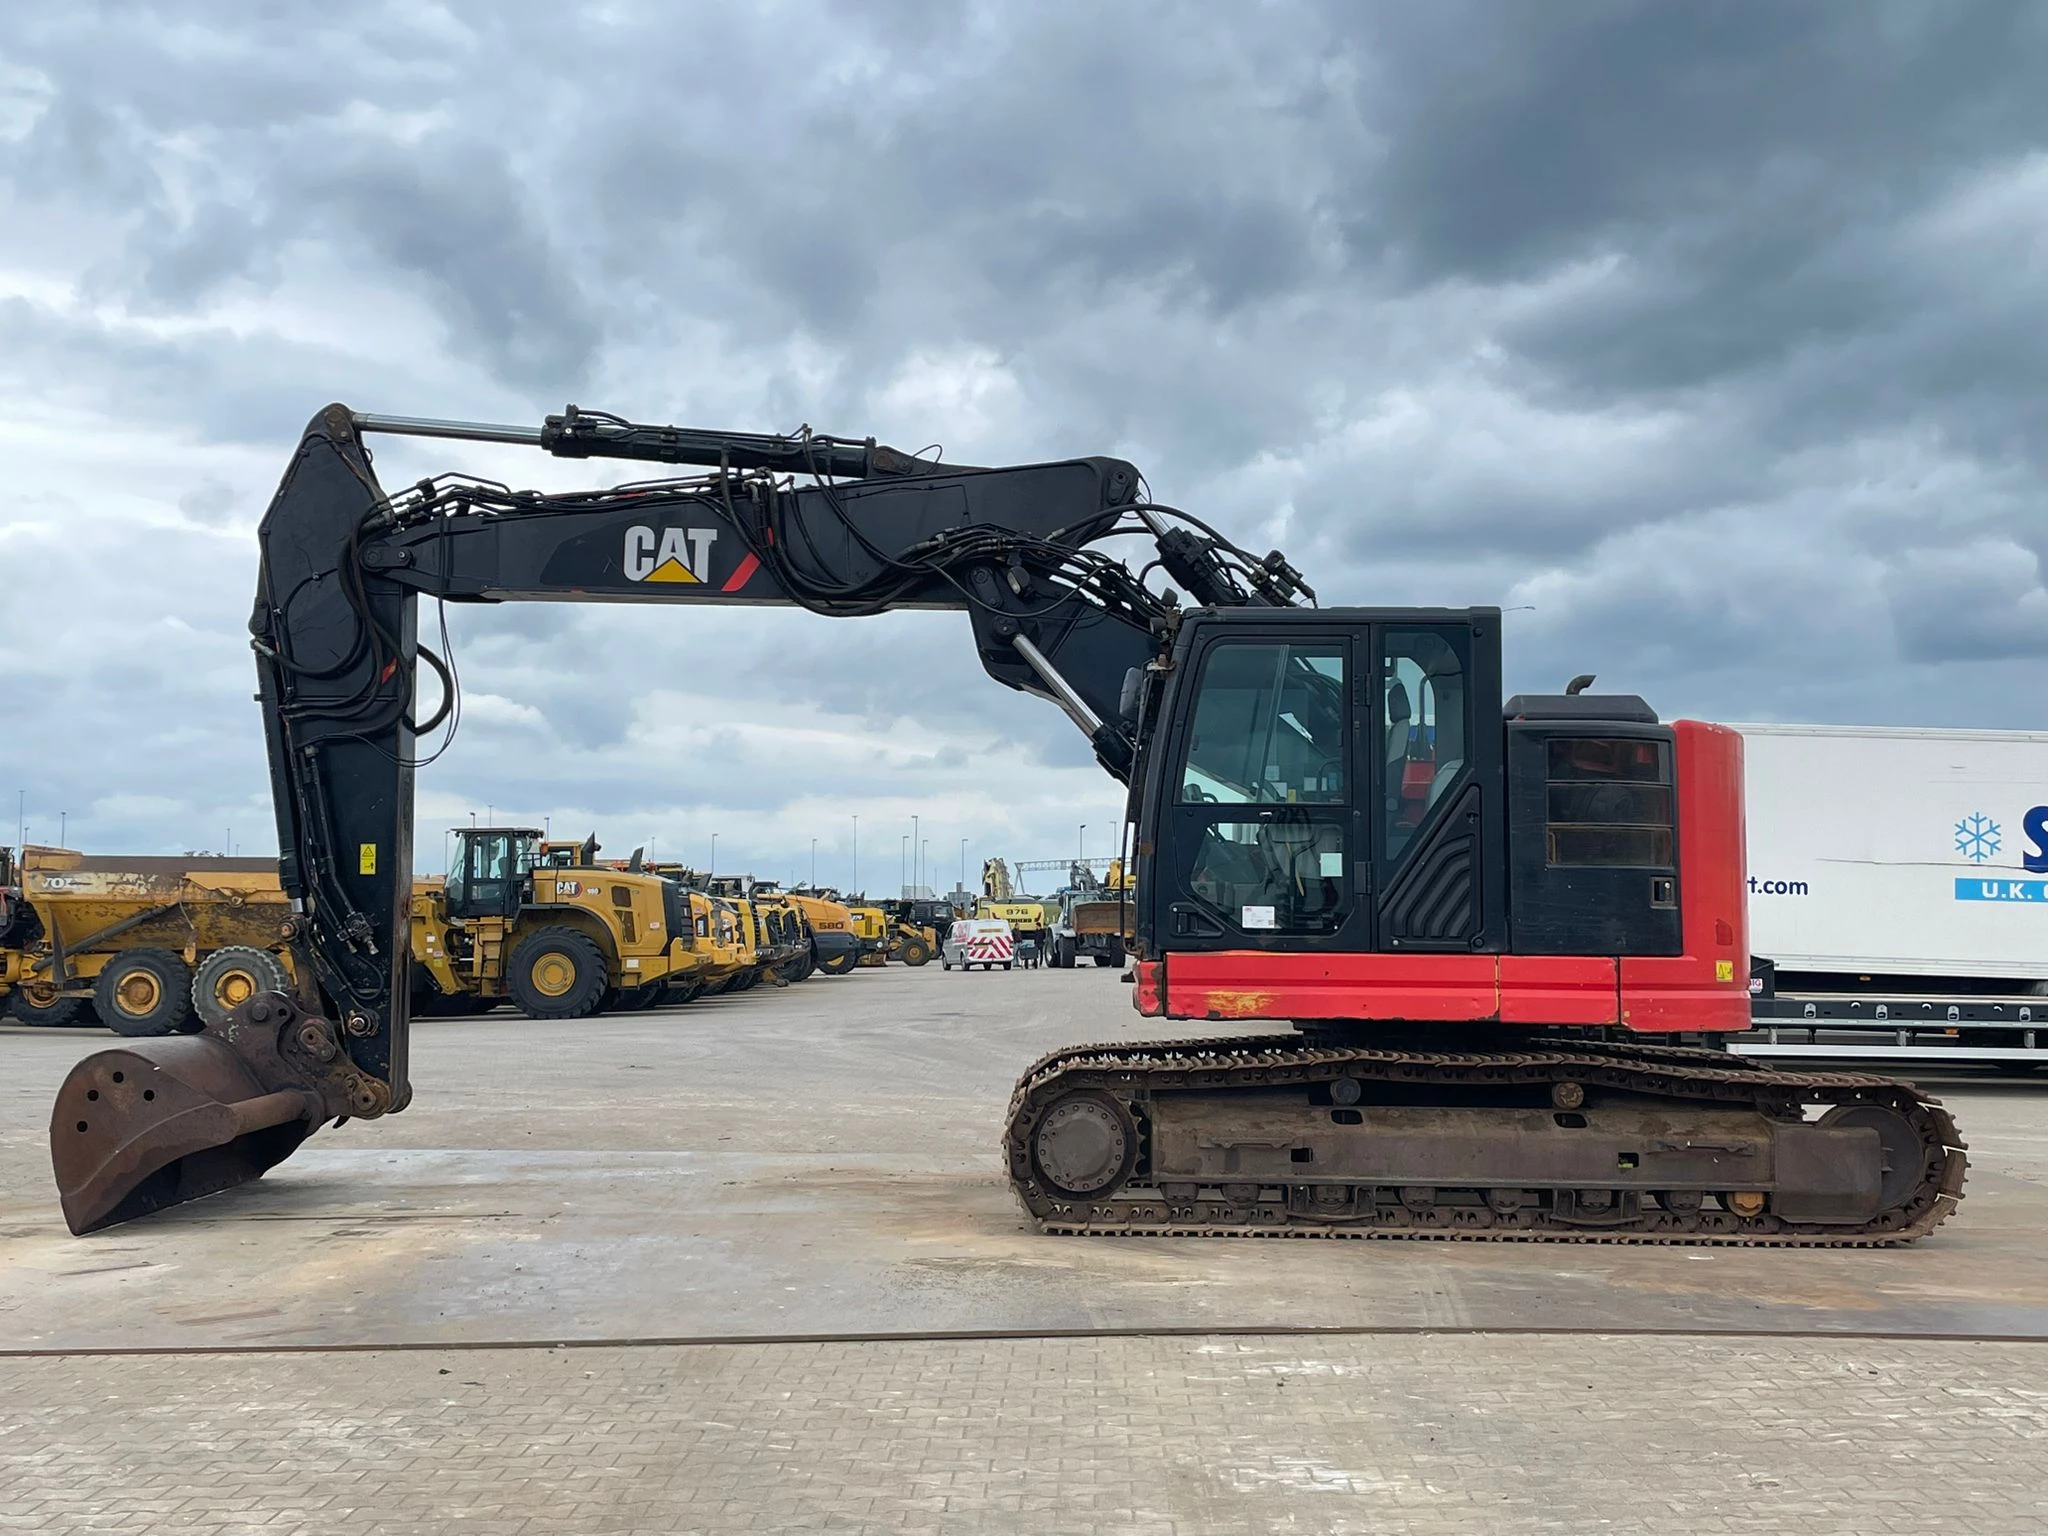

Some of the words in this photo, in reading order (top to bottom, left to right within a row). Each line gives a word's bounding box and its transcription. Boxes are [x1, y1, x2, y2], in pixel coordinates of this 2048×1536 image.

[623, 525, 717, 584] CAT
[557, 882, 577, 895] CAT
[1747, 875, 1809, 895] t.com
[1982, 881, 2033, 899] U.K.
[819, 922, 844, 930] 580
